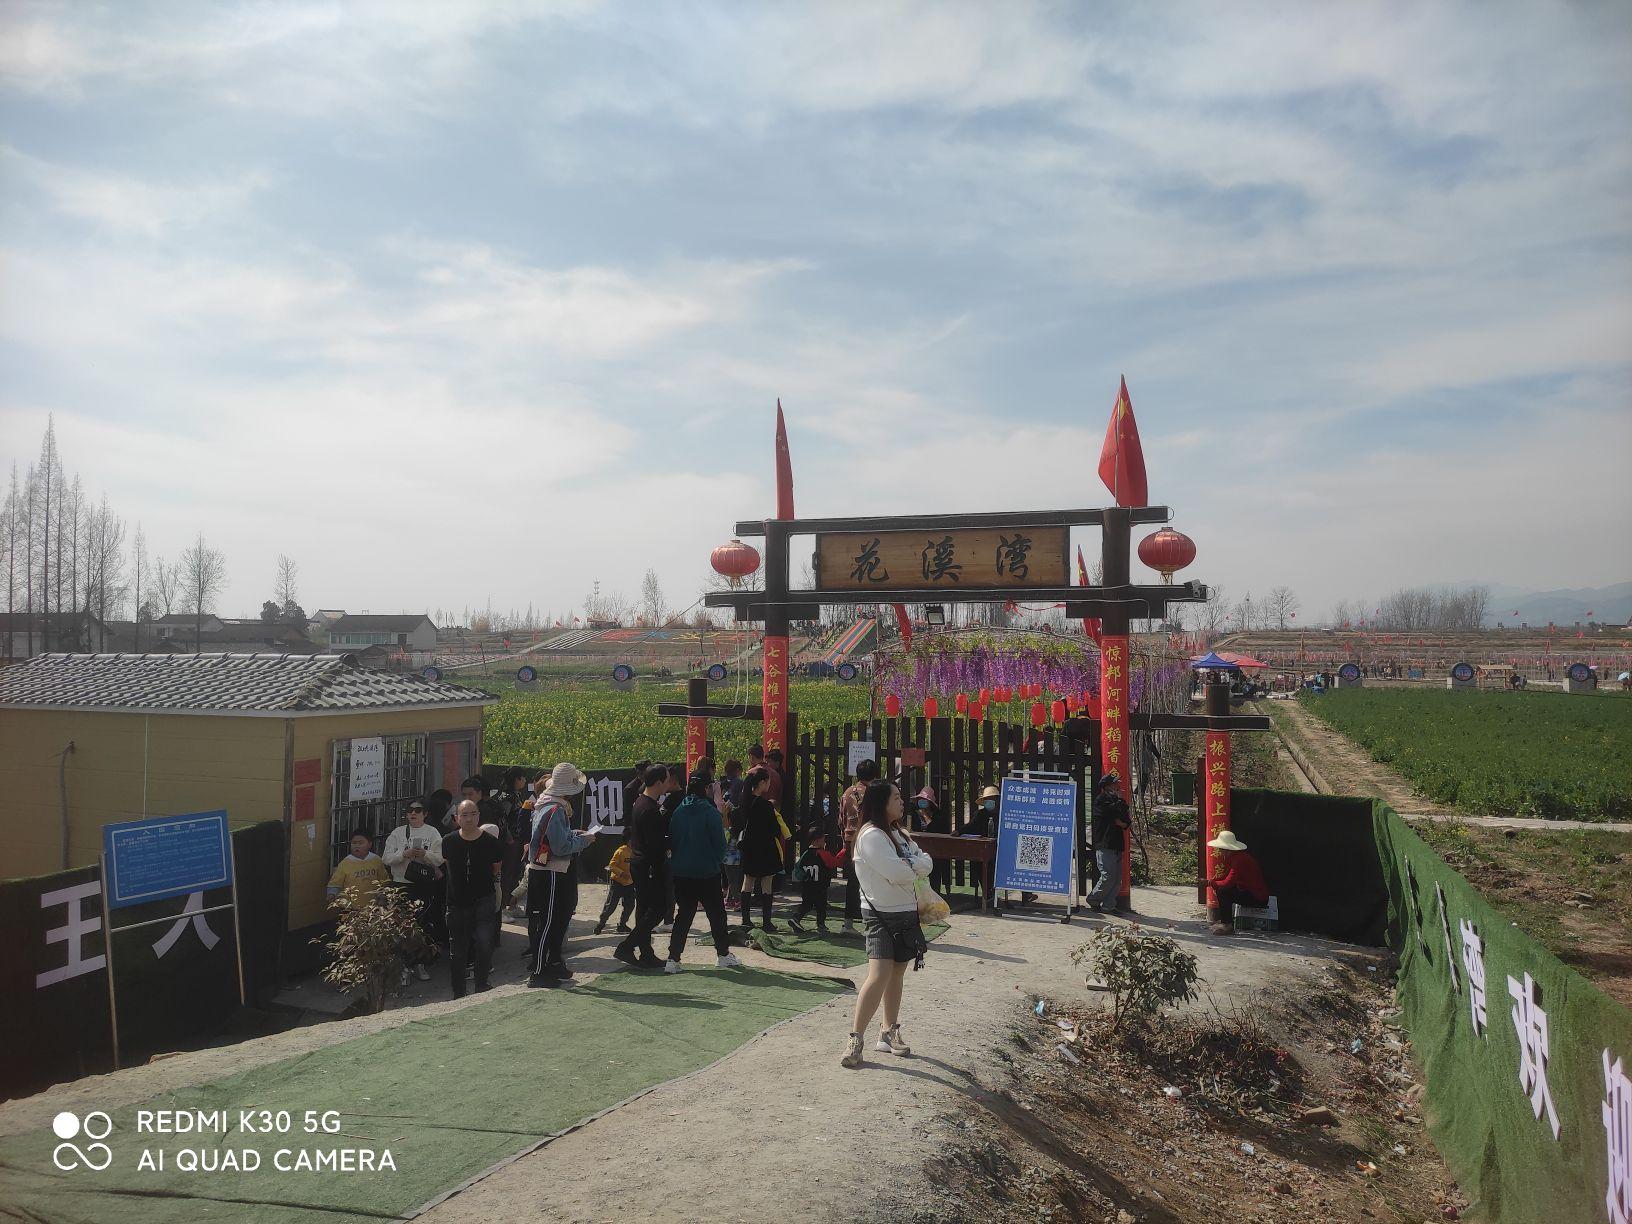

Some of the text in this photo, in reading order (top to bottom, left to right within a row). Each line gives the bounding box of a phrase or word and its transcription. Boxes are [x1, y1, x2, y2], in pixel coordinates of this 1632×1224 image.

[849, 533, 1033, 584] 花溪湾
[585, 776, 625, 835] 迎
